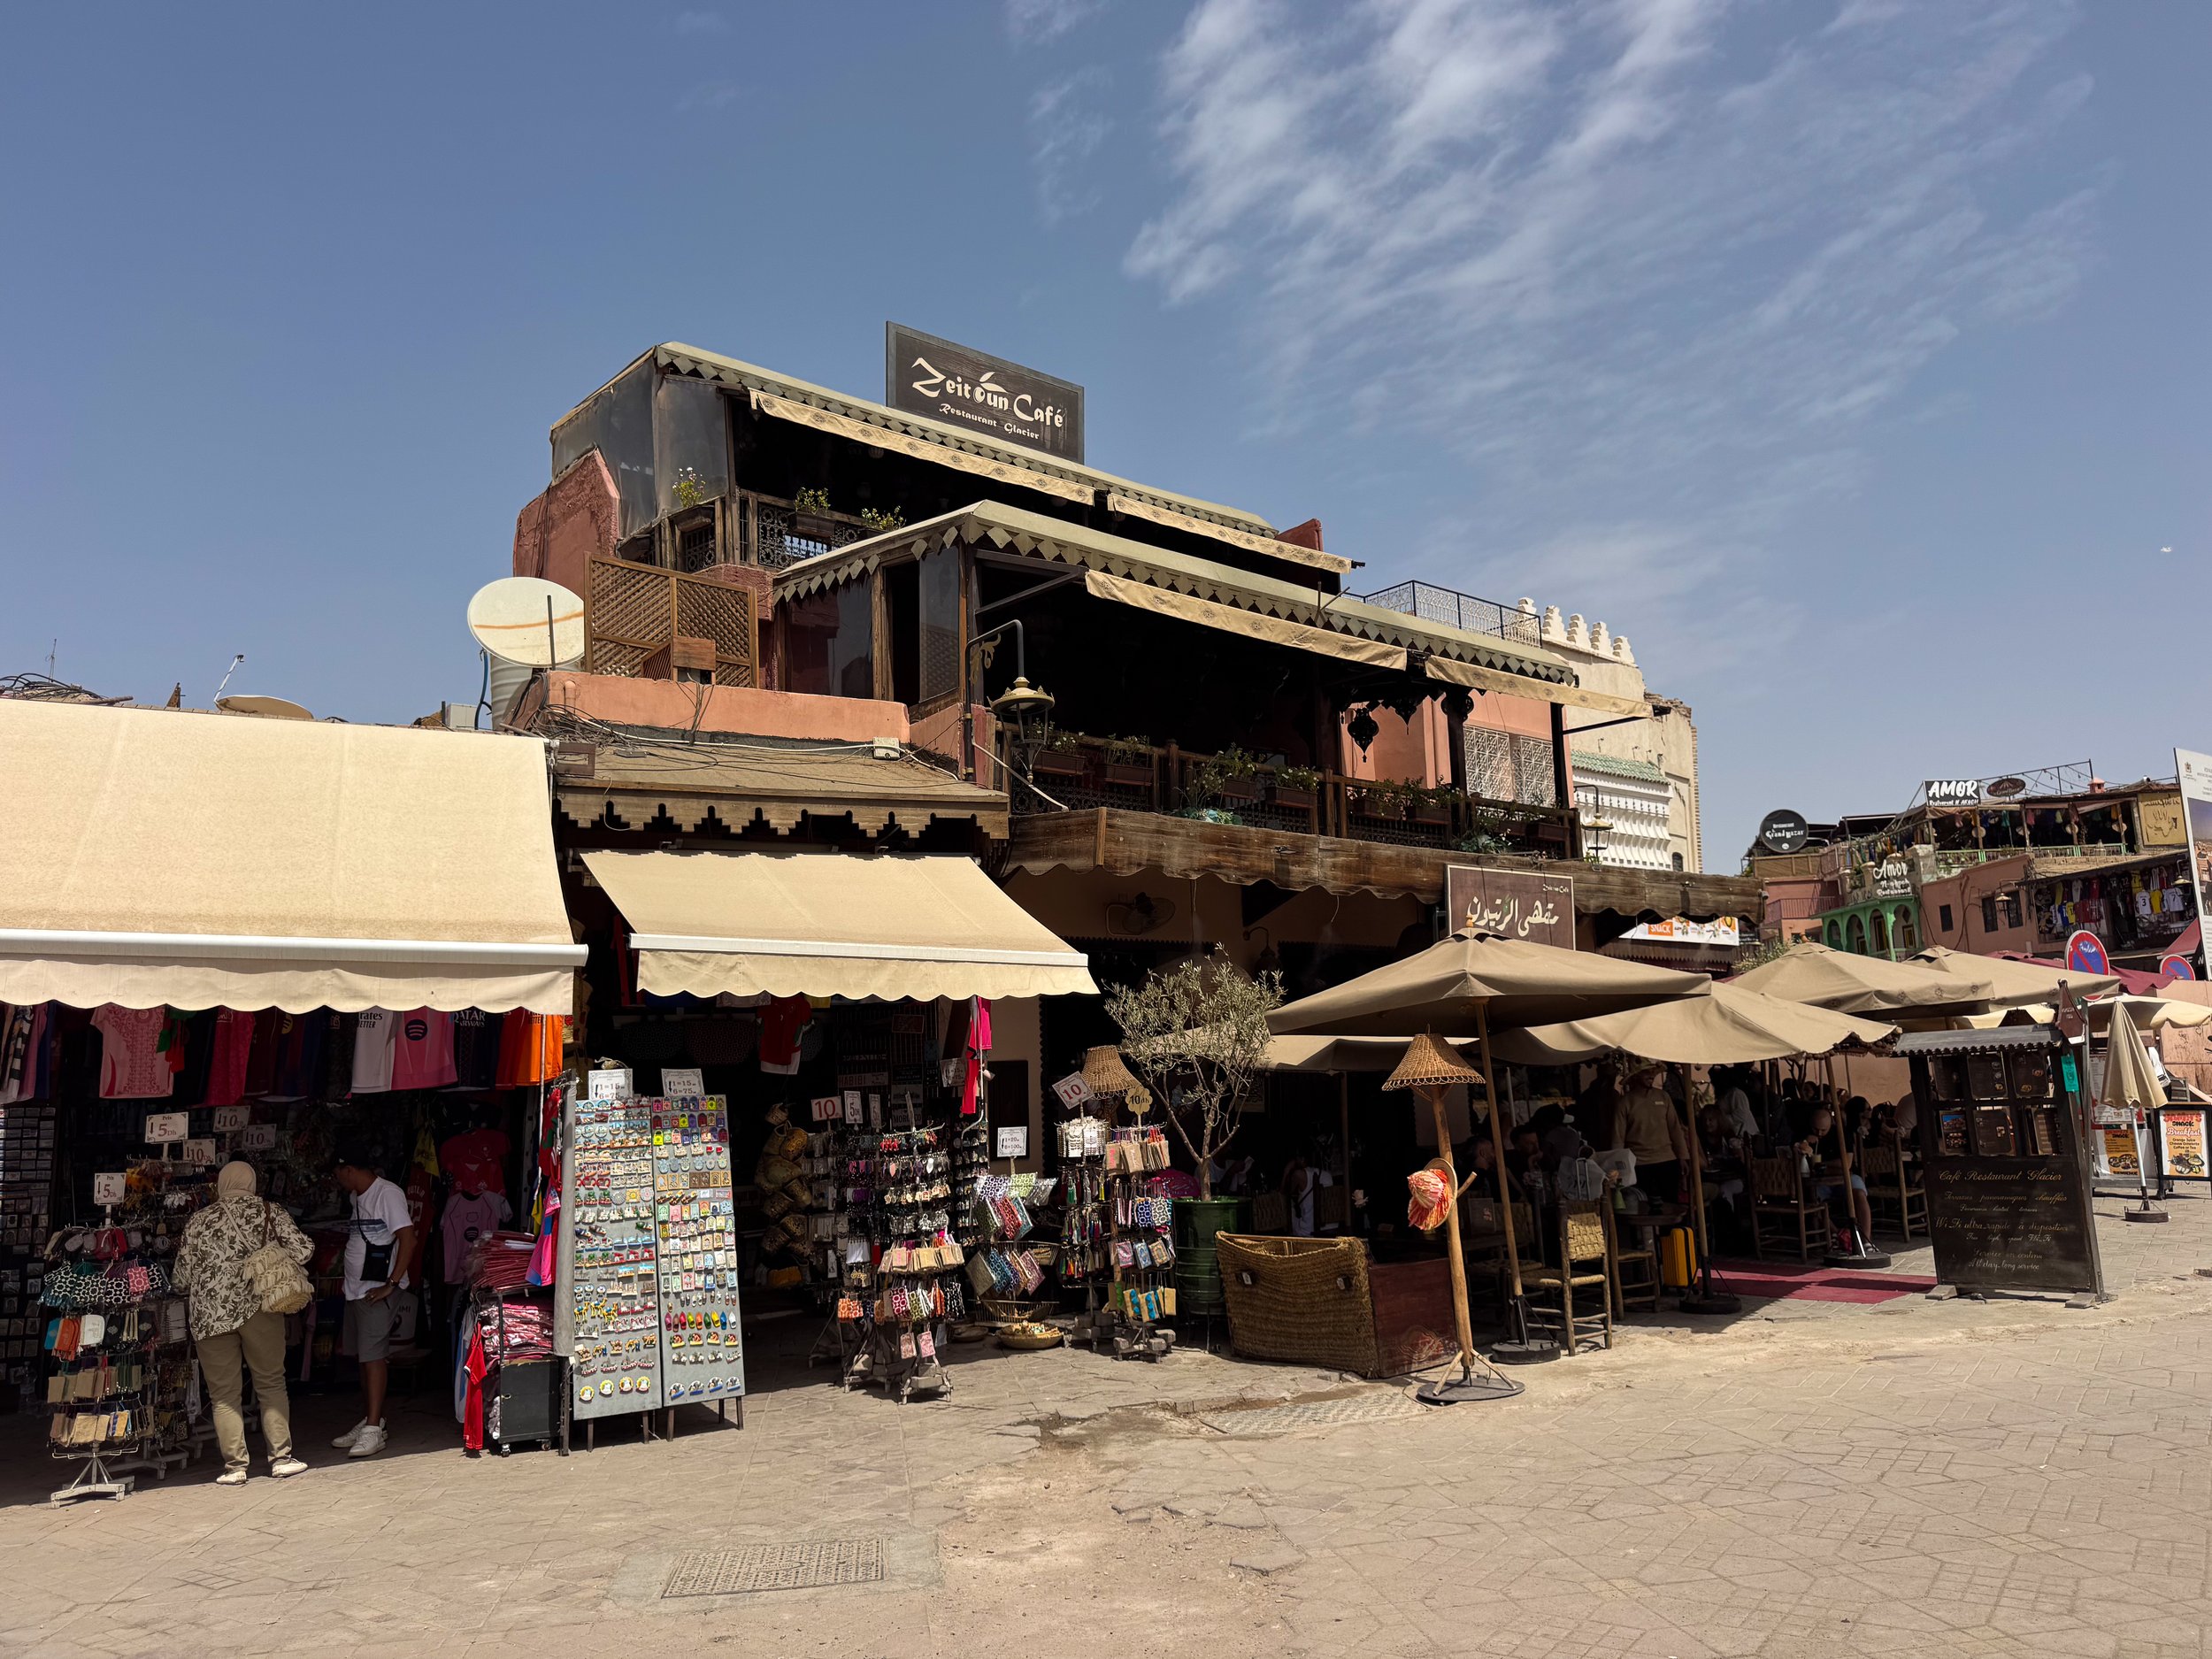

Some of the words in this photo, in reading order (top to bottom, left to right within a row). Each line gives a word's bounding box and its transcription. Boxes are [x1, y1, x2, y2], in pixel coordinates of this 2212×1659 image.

[910, 357, 1009, 411] Zeitoun
[1012, 393, 1064, 427] Café
[939, 403, 997, 427] Restaurant
[1003, 422, 1040, 440] Glacier
[1928, 780, 1979, 799] AMOR
[1873, 858, 1909, 879] Amor
[1650, 924, 1671, 934] SNACK
[359, 1011, 383, 1020] rates
[1062, 1084, 1082, 1101] 10
[814, 1099, 836, 1119] 10
[2166, 1126, 2201, 1138] Breakfast
[1939, 1169, 1962, 1184] Café
[1964, 1169, 2023, 1181] Restaurant
[2027, 1167, 2063, 1181] Glacier
